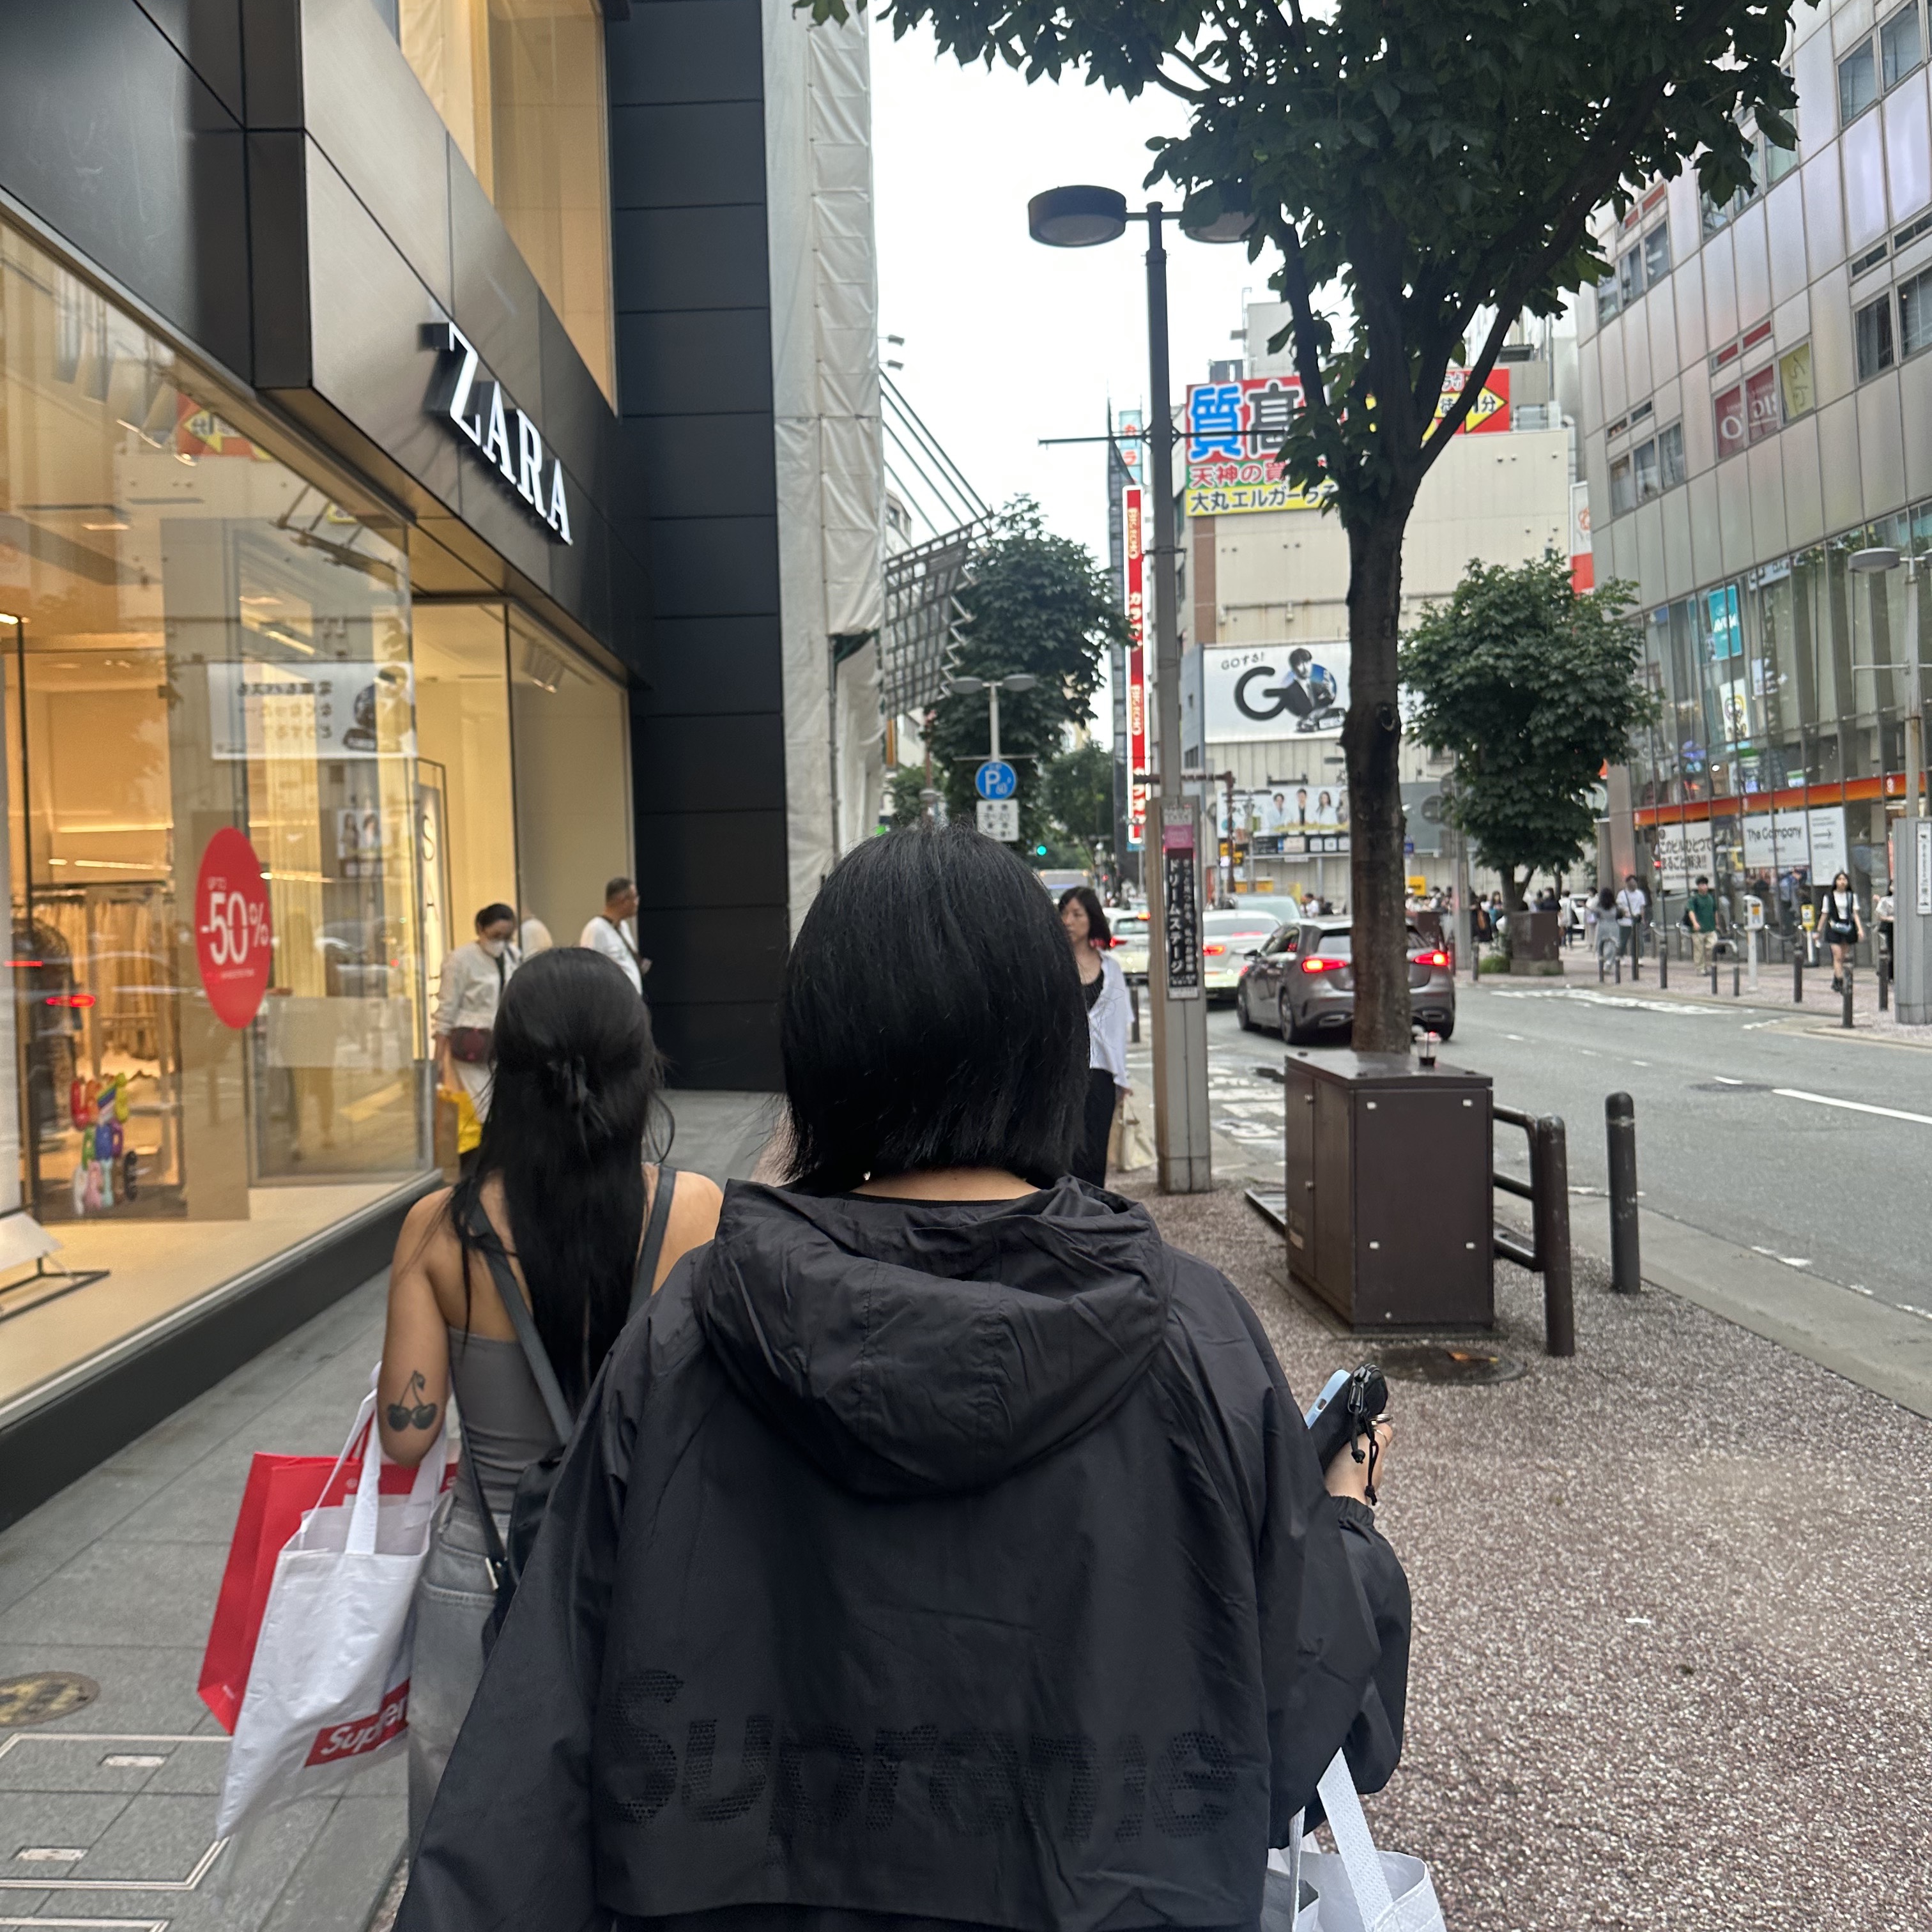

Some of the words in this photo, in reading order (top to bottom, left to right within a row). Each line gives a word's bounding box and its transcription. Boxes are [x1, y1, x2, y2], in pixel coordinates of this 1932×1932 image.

[448, 320, 572, 546] ZARA
[985, 770, 1000, 795] P
[1746, 829, 1761, 843] The
[1761, 826, 1801, 839] Company
[1169, 859, 1183, 974] ドリームステージ
